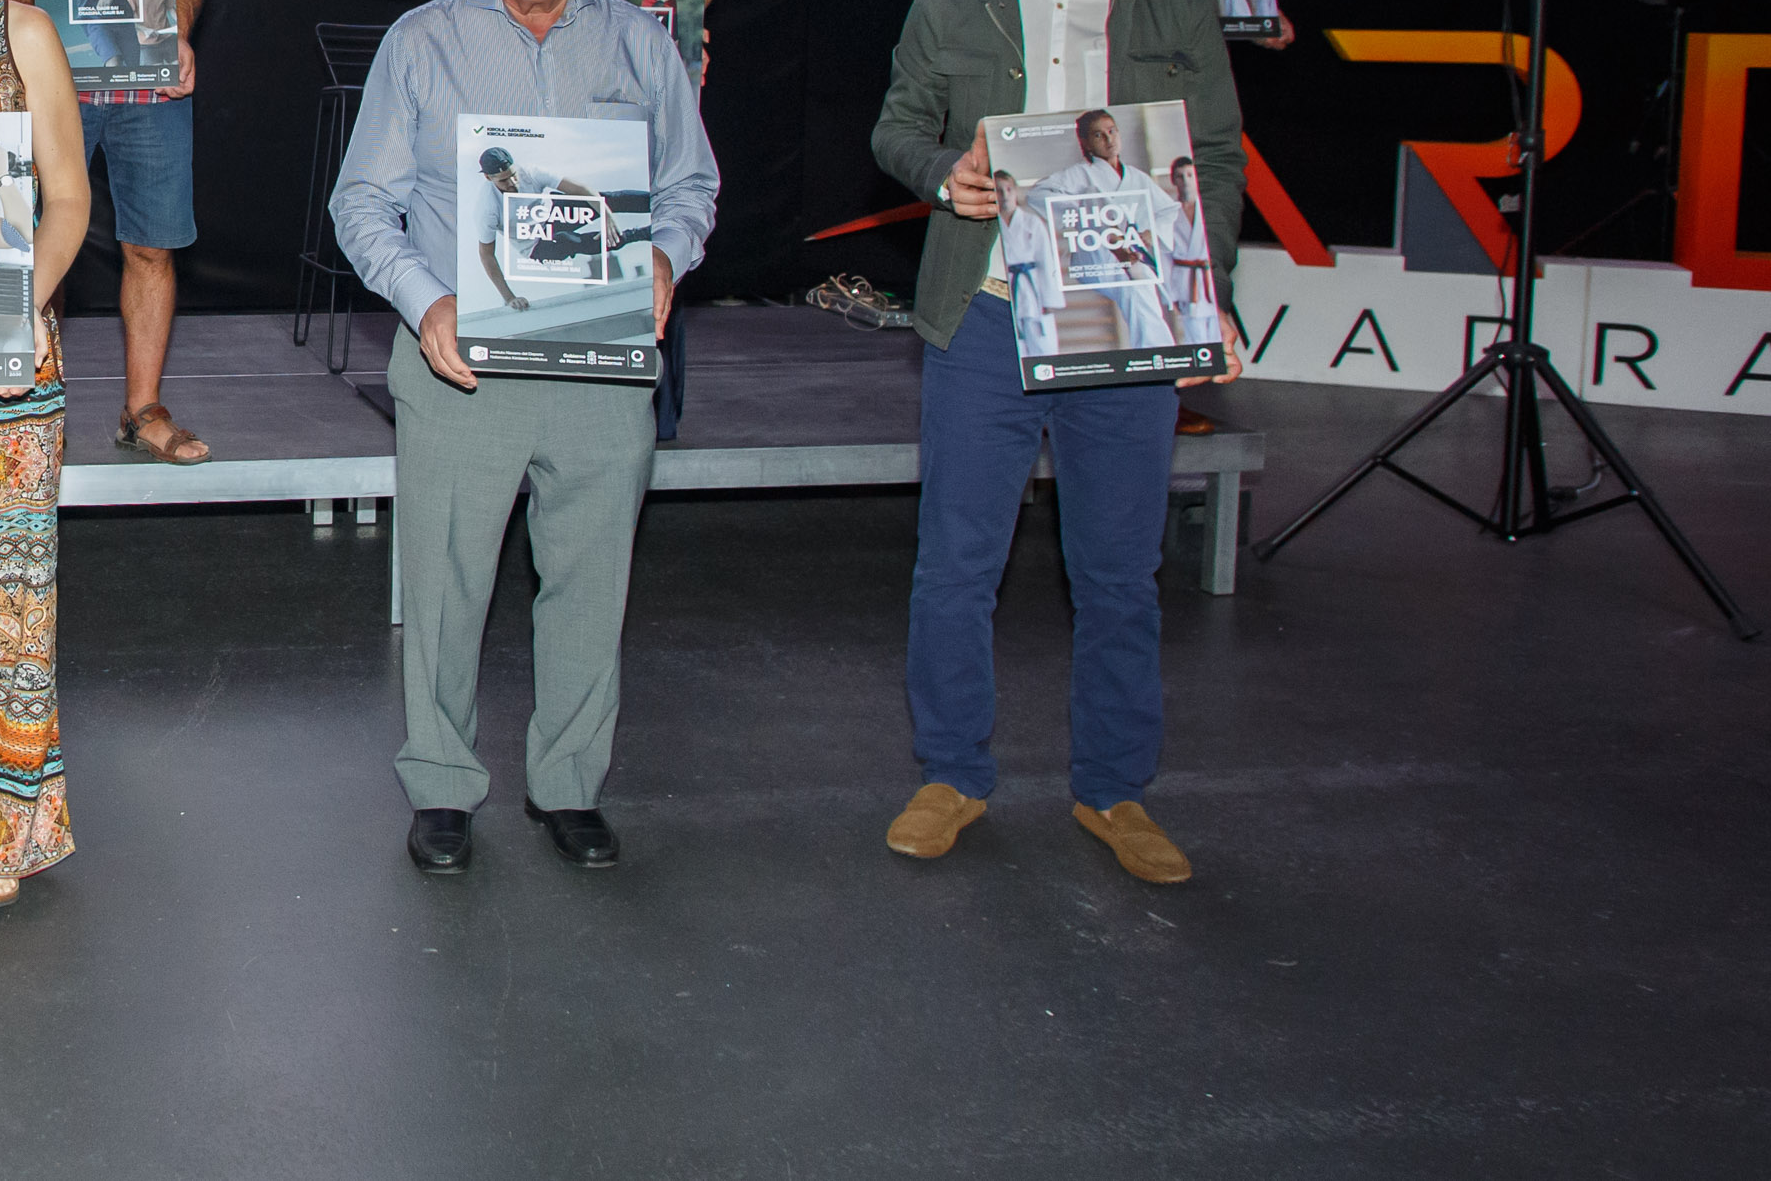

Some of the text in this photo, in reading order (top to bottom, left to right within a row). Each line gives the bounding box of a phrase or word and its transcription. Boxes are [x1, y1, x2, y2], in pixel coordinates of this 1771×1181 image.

[515, 205, 595, 225] #GAUR
[1062, 201, 1139, 229] #HOY
[516, 223, 554, 241] BAI
[1063, 226, 1145, 253] TOCA
